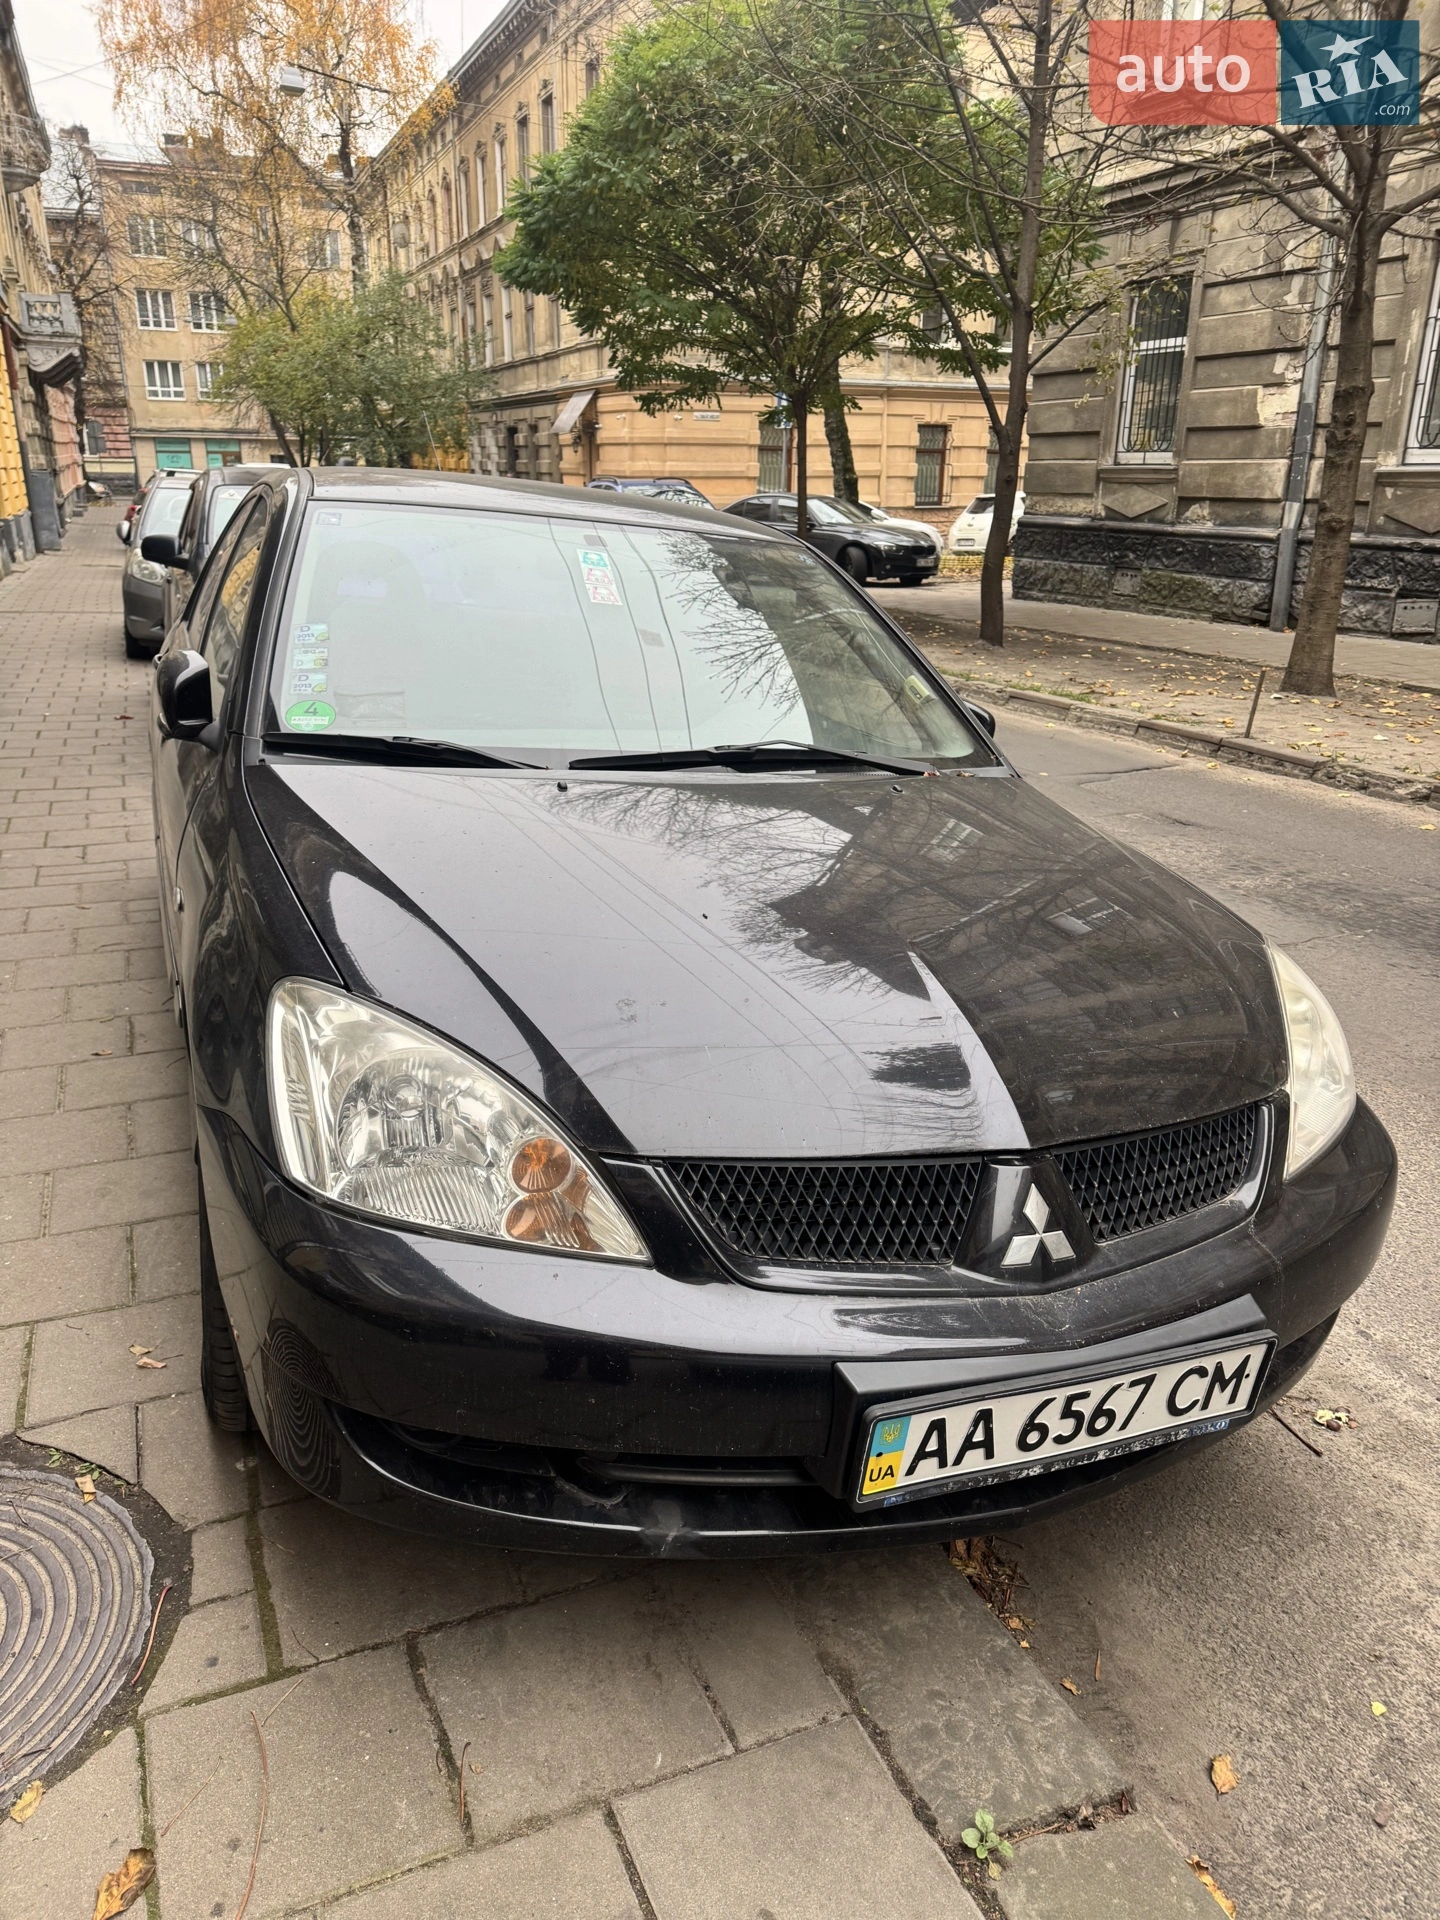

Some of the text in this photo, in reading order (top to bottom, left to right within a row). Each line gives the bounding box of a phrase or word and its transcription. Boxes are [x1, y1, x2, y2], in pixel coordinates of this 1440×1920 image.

[304, 702, 318, 716] 4
[905, 1408, 994, 1476] AA
[1016, 1373, 1157, 1452] 6567
[1166, 1353, 1251, 1417] CM
[868, 1467, 895, 1483] UA
